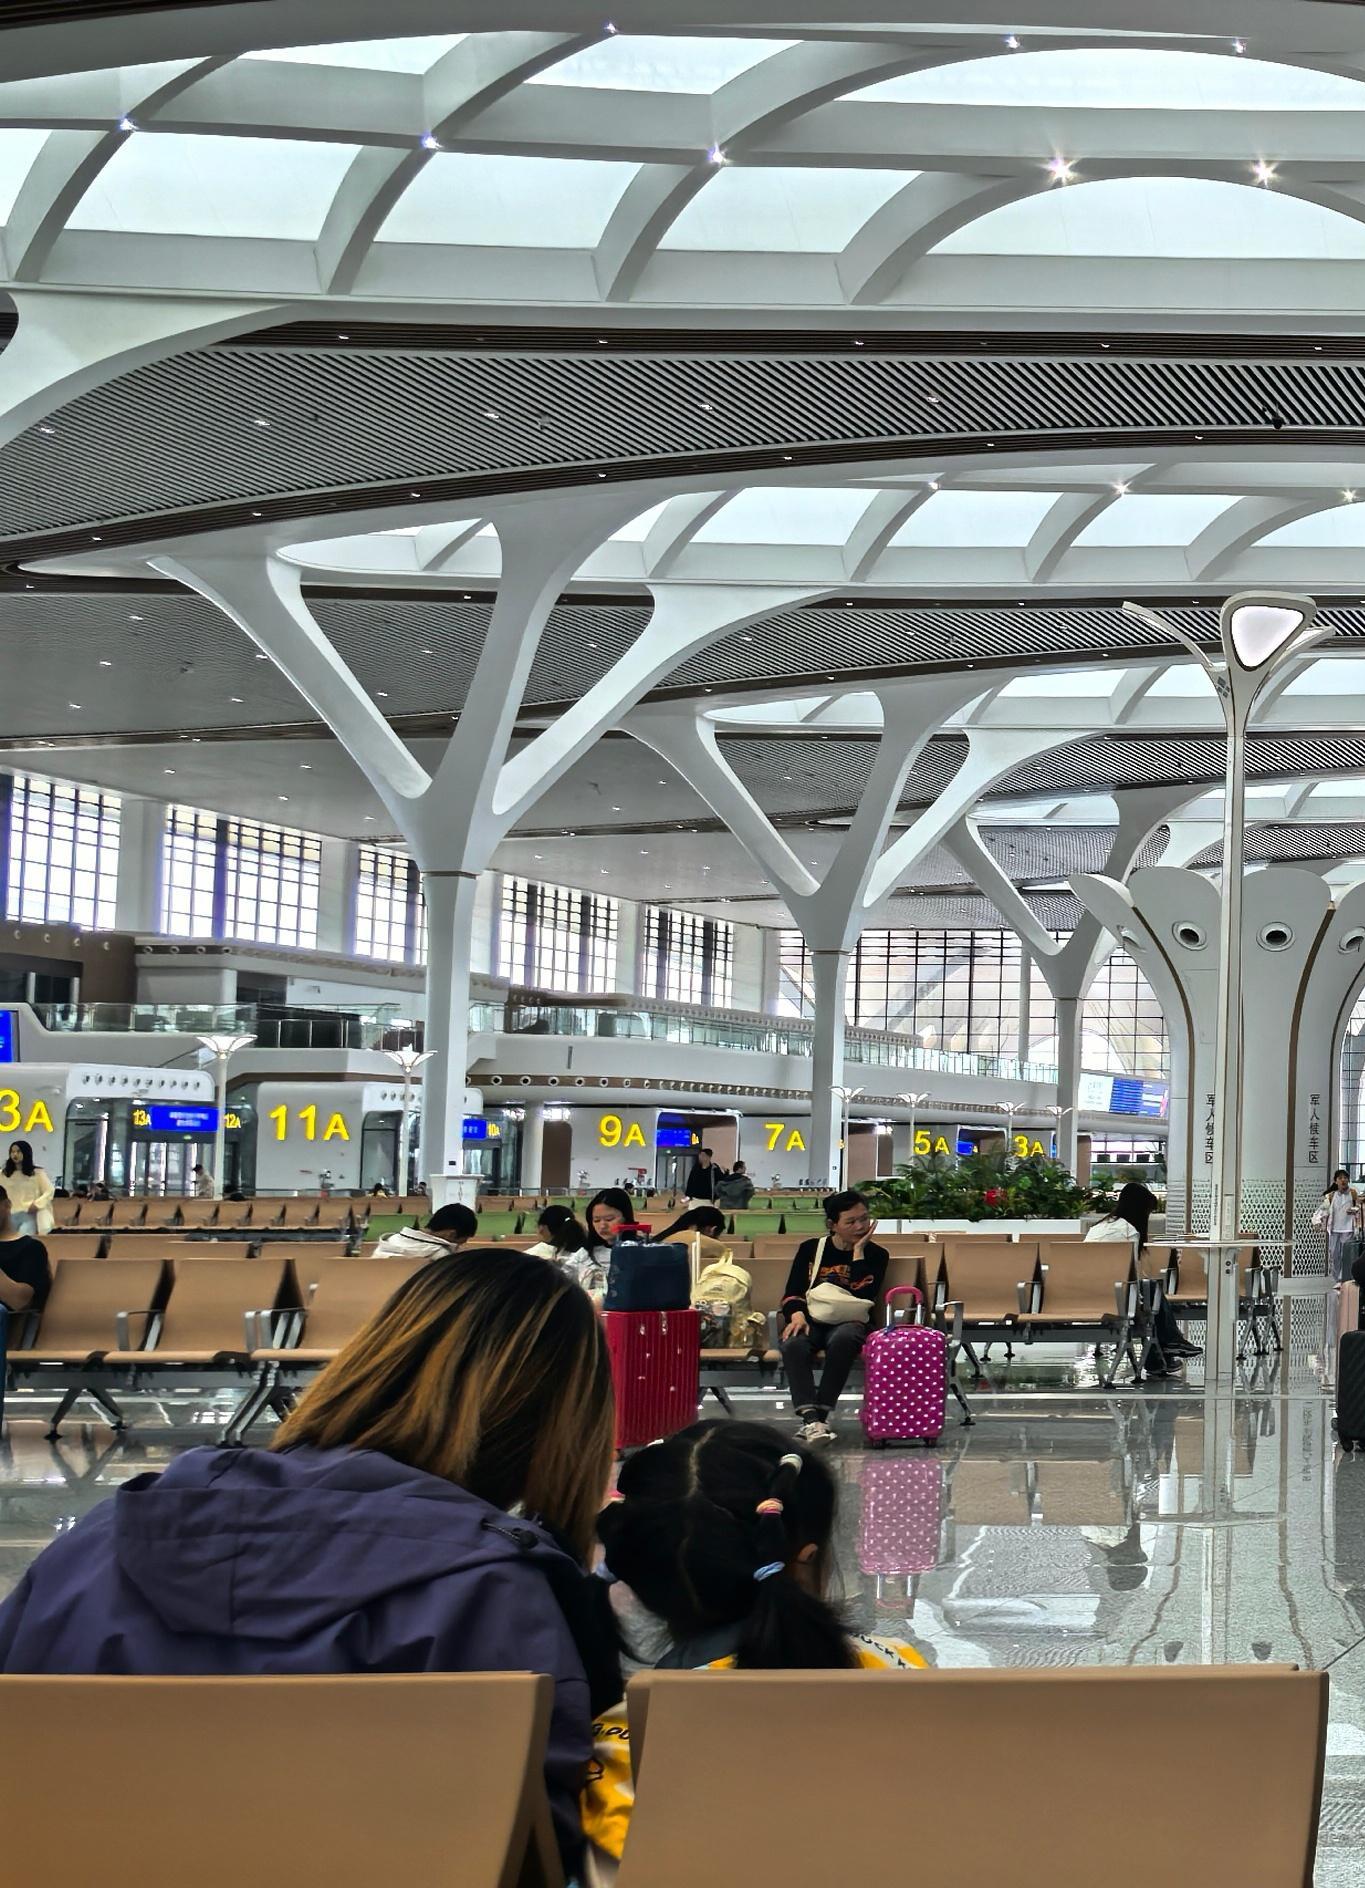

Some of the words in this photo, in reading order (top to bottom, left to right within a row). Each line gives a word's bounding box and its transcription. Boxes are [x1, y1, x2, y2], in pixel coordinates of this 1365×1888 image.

[132, 1109, 153, 1126] 13A
[268, 1103, 351, 1142] 11A
[598, 1113, 647, 1148] 9A
[1309, 1094, 1320, 1163] 军人候车区
[763, 1122, 806, 1152] 7A
[912, 1129, 951, 1156] 5A
[1012, 1133, 1045, 1159] 3A
